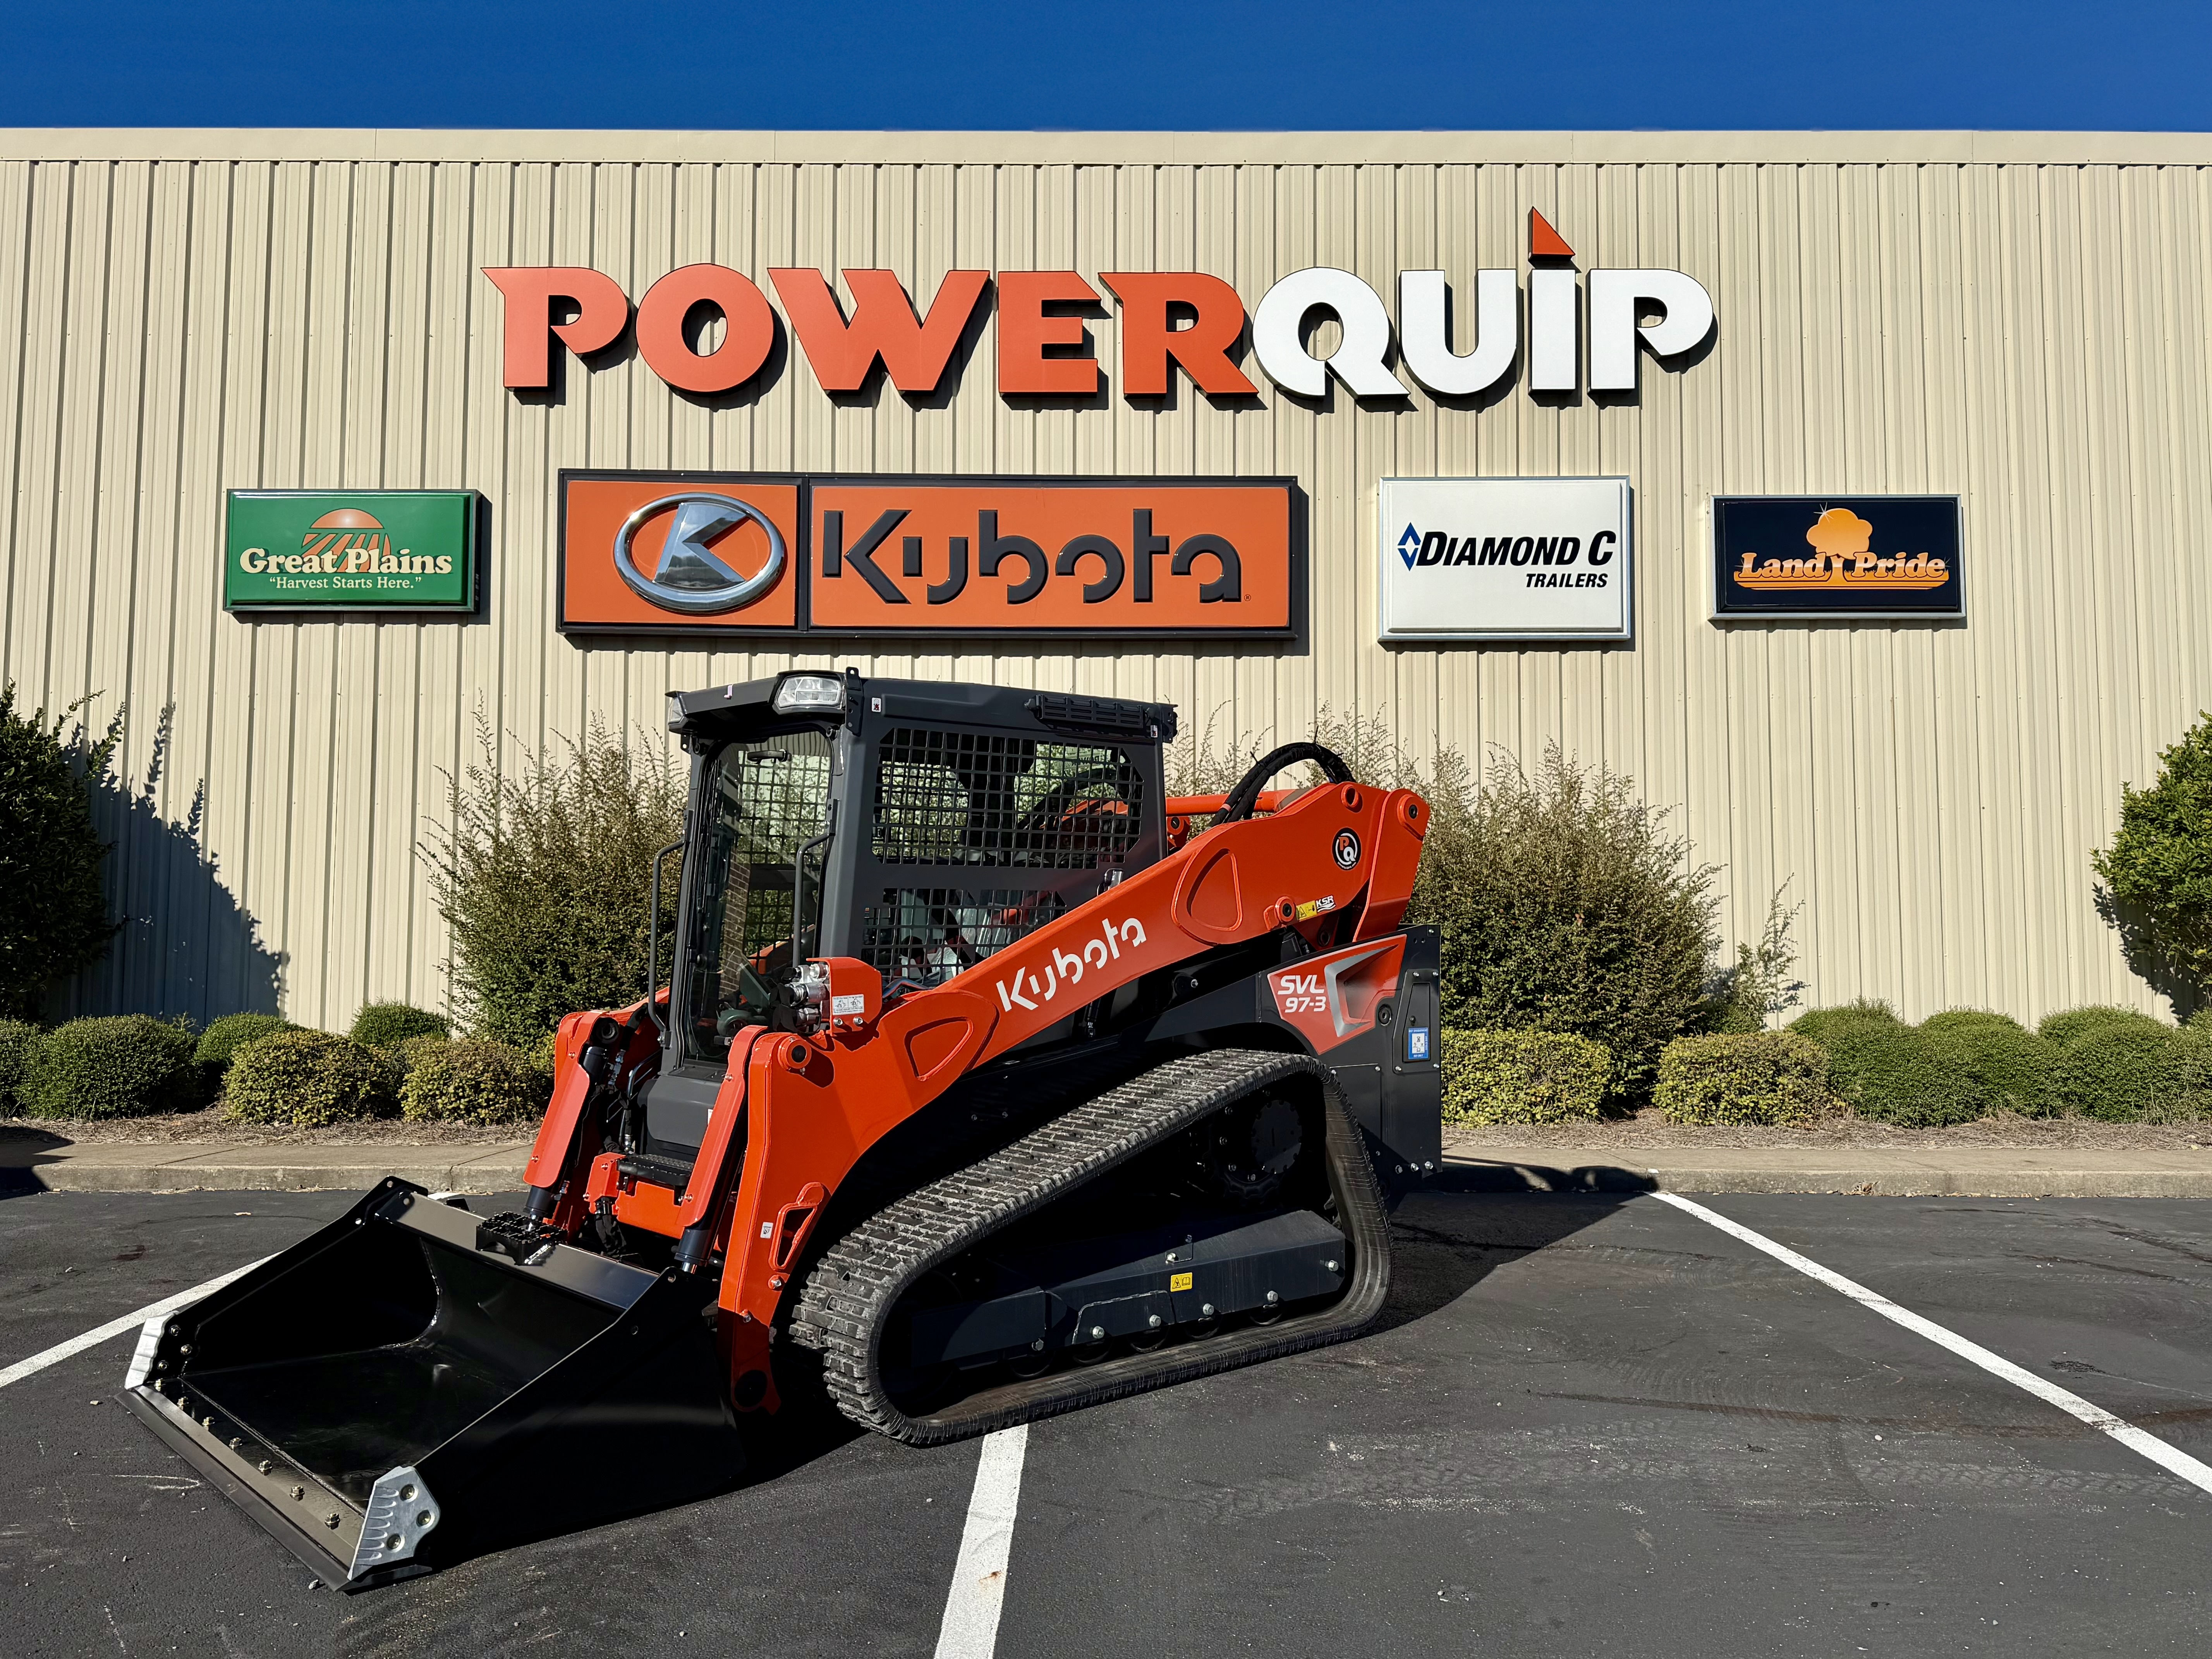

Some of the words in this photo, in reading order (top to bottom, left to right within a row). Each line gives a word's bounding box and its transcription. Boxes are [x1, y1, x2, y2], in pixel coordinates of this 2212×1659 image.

[480, 206, 1713, 395] POWERQUIP
[239, 548, 339, 573] Great
[345, 548, 452, 574] Plains
[823, 508, 1242, 605] Kubota
[1416, 531, 1580, 566] DIAMOND
[1588, 530, 1616, 566] C
[1738, 552, 1827, 579] Land
[1851, 551, 1946, 579] Pride
[333, 577, 373, 588] Starts
[1526, 573, 1608, 588] TRAILERS
[1316, 895, 1334, 907] KSR
[996, 917, 1147, 1012] Kubota
[1277, 975, 1325, 995] SVL
[1284, 996, 1327, 1013] 97-3
